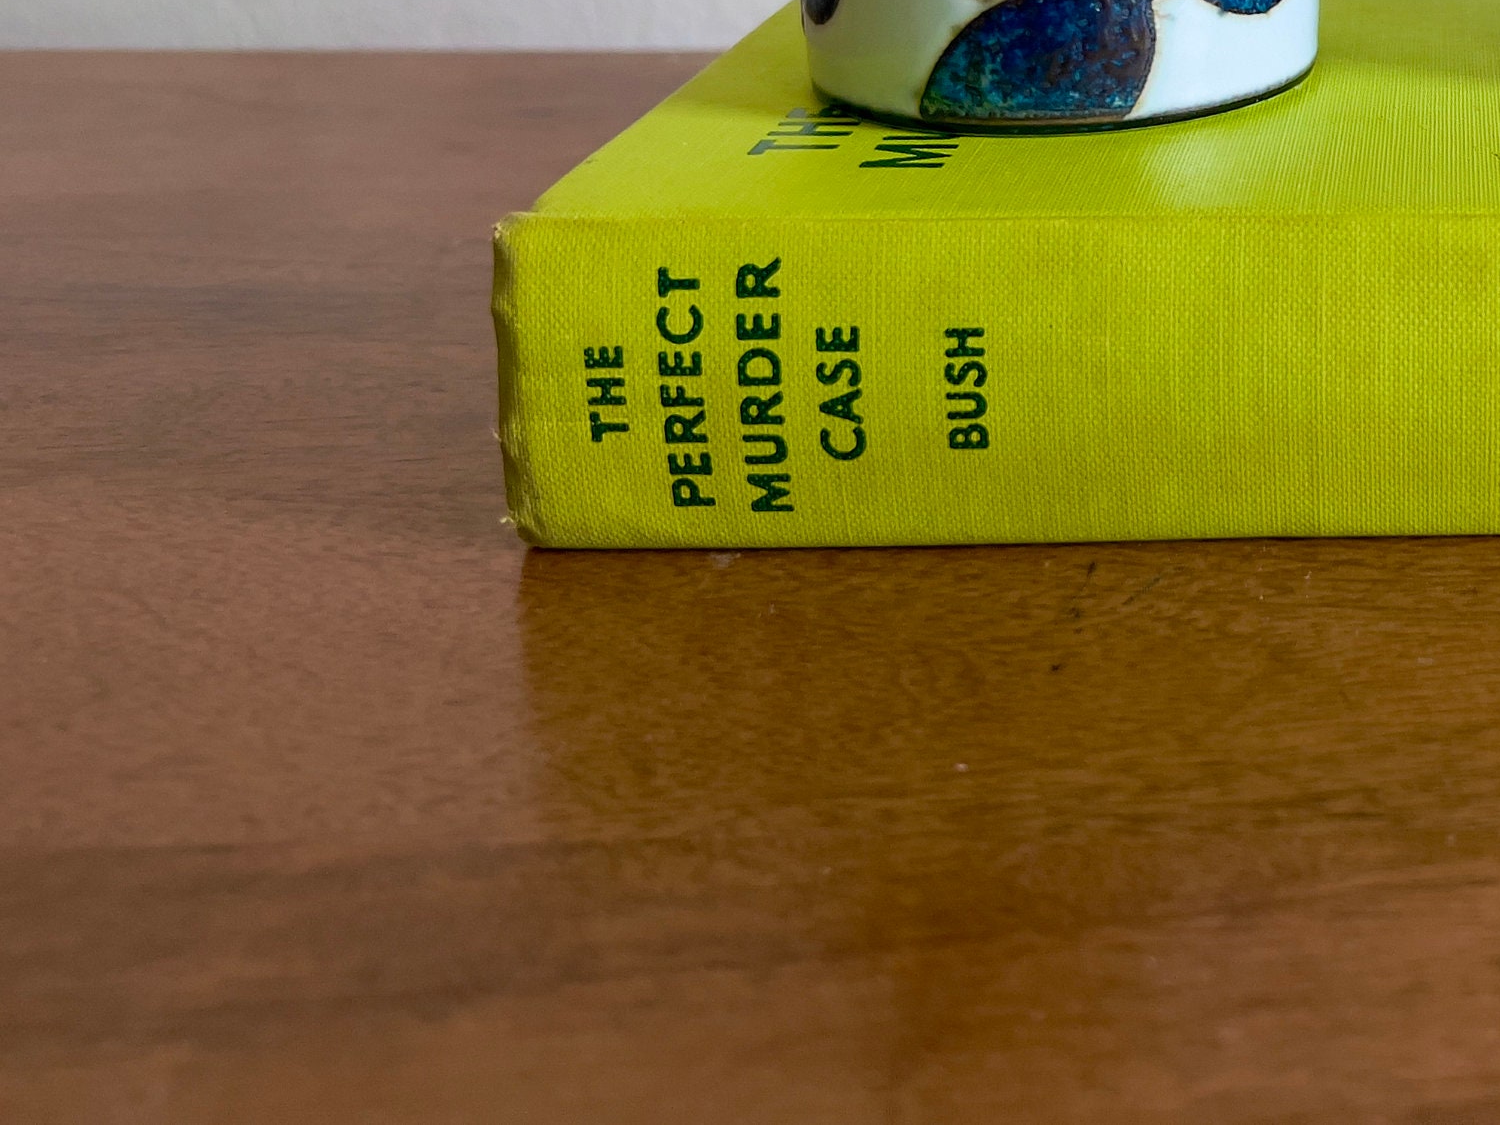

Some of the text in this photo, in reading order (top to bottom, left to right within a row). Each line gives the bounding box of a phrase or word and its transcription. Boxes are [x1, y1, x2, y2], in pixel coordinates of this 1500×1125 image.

[584, 345, 629, 442] THE
[657, 266, 716, 507] PERFECT
[735, 257, 795, 512] MURDER
[815, 325, 867, 461] CASE
[944, 327, 990, 450] BUSH
